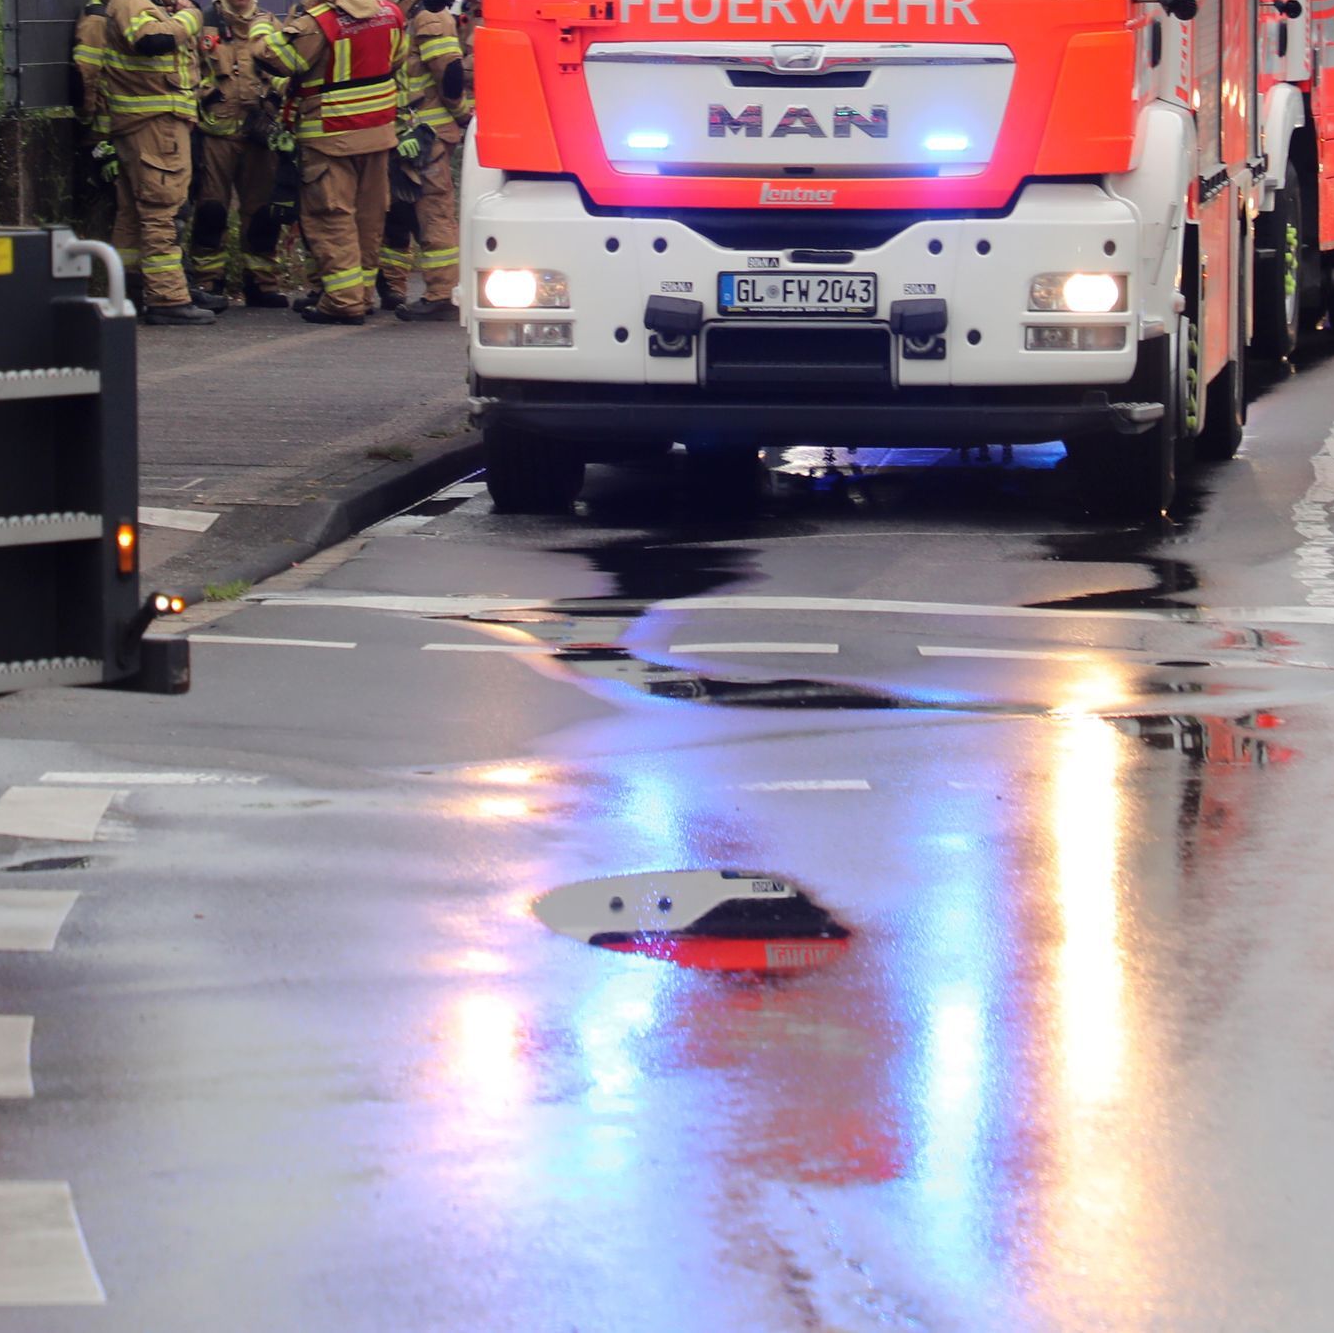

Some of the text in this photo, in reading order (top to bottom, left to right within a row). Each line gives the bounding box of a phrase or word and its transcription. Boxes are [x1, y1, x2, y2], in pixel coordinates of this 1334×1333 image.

[708, 104, 888, 138] MAN
[737, 279, 871, 303] GL FW 2043
